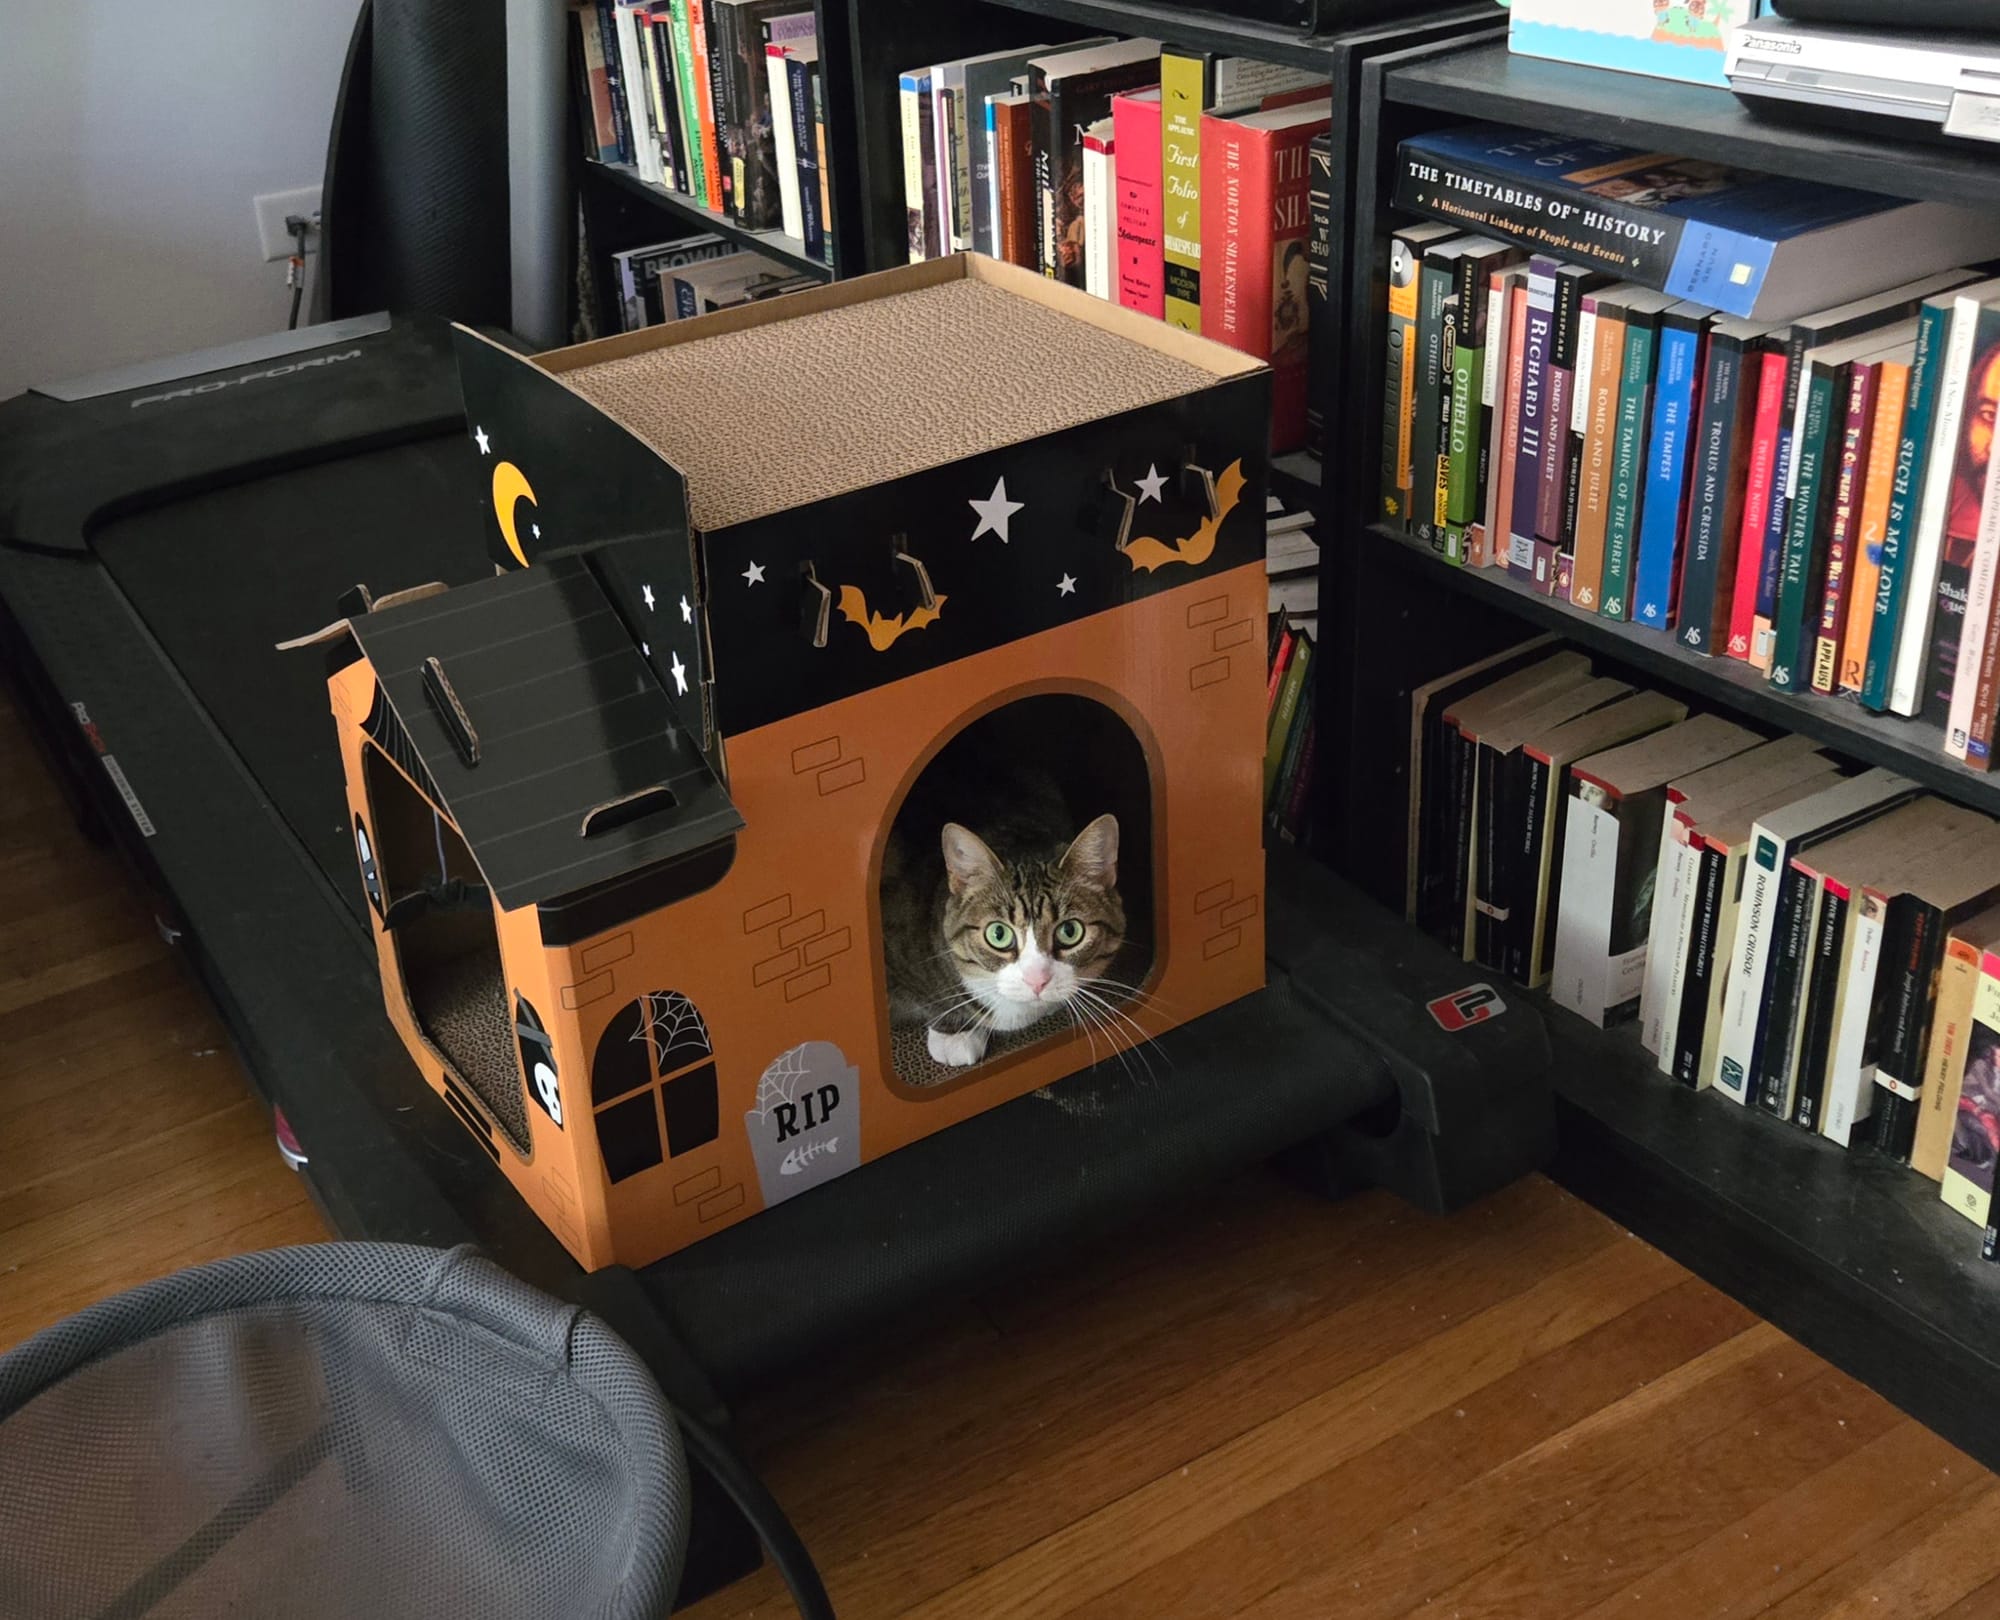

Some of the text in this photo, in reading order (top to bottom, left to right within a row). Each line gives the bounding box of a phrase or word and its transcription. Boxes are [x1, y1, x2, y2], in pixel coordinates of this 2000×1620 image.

[1743, 34, 1802, 54] Panasonic
[1167, 143, 1200, 169] First
[1274, 147, 1310, 183] TH
[1167, 174, 1198, 201] Folio
[1408, 162, 1439, 183] THE
[1444, 172, 1543, 212] TIMETABLES
[1582, 211, 1667, 246] HISTORY
[1224, 142, 1239, 332] THE NORTON SHAKESPEARE
[1432, 198, 1626, 264] A Horizontal Linkage of People and Events
[1463, 264, 1472, 333] SHAKESPEARE
[1558, 281, 1569, 358] SHAKESPEARE
[1428, 334, 1438, 385] OTHELLO
[1920, 319, 1932, 354] Joseph
[1512, 354, 1522, 387] KING
[1522, 318, 1547, 456] RICHARD III
[1552, 371, 1562, 412] ROMEO
[1788, 340, 1802, 410] SHAKESPEARE
[1452, 368, 1468, 452] OTHELLO
[1508, 390, 1520, 449] RICHARD
[1550, 414, 1558, 441] AND
[1546, 441, 1556, 481] JULIET
[1588, 388, 1608, 512] ROMEO AND JULIET
[1661, 402, 1677, 480] THE TEMPEST
[1802, 454, 1815, 478] THE
[1570, 457, 1578, 485] ROMEO
[1612, 398, 1636, 576] THE TAMING OF THE SHREW
[1698, 422, 1722, 560] TROILUS AND CRESSIDA
[1750, 440, 1768, 528] TWELFTH NIGHT
[1772, 435, 1790, 534] TWELFTH NIGHT
[1564, 505, 1573, 531] JULIET
[1834, 506, 1850, 541] WORKS
[1876, 438, 1914, 615] SUCH IS MY LOVE
[1788, 554, 1801, 581] TALE
[1832, 544, 1842, 558] OF
[1976, 551, 1989, 607] COMEDIES
[1818, 640, 1832, 688] APPLAUSE
[1743, 874, 1766, 976] ROBINSON CRUSOE
[1789, 924, 1799, 958] FLANDERS
[1824, 924, 1833, 956] ROXANA
[1935, 1058, 1948, 1111] HENRY FIELDING
[773, 1083, 841, 1144] RIP
